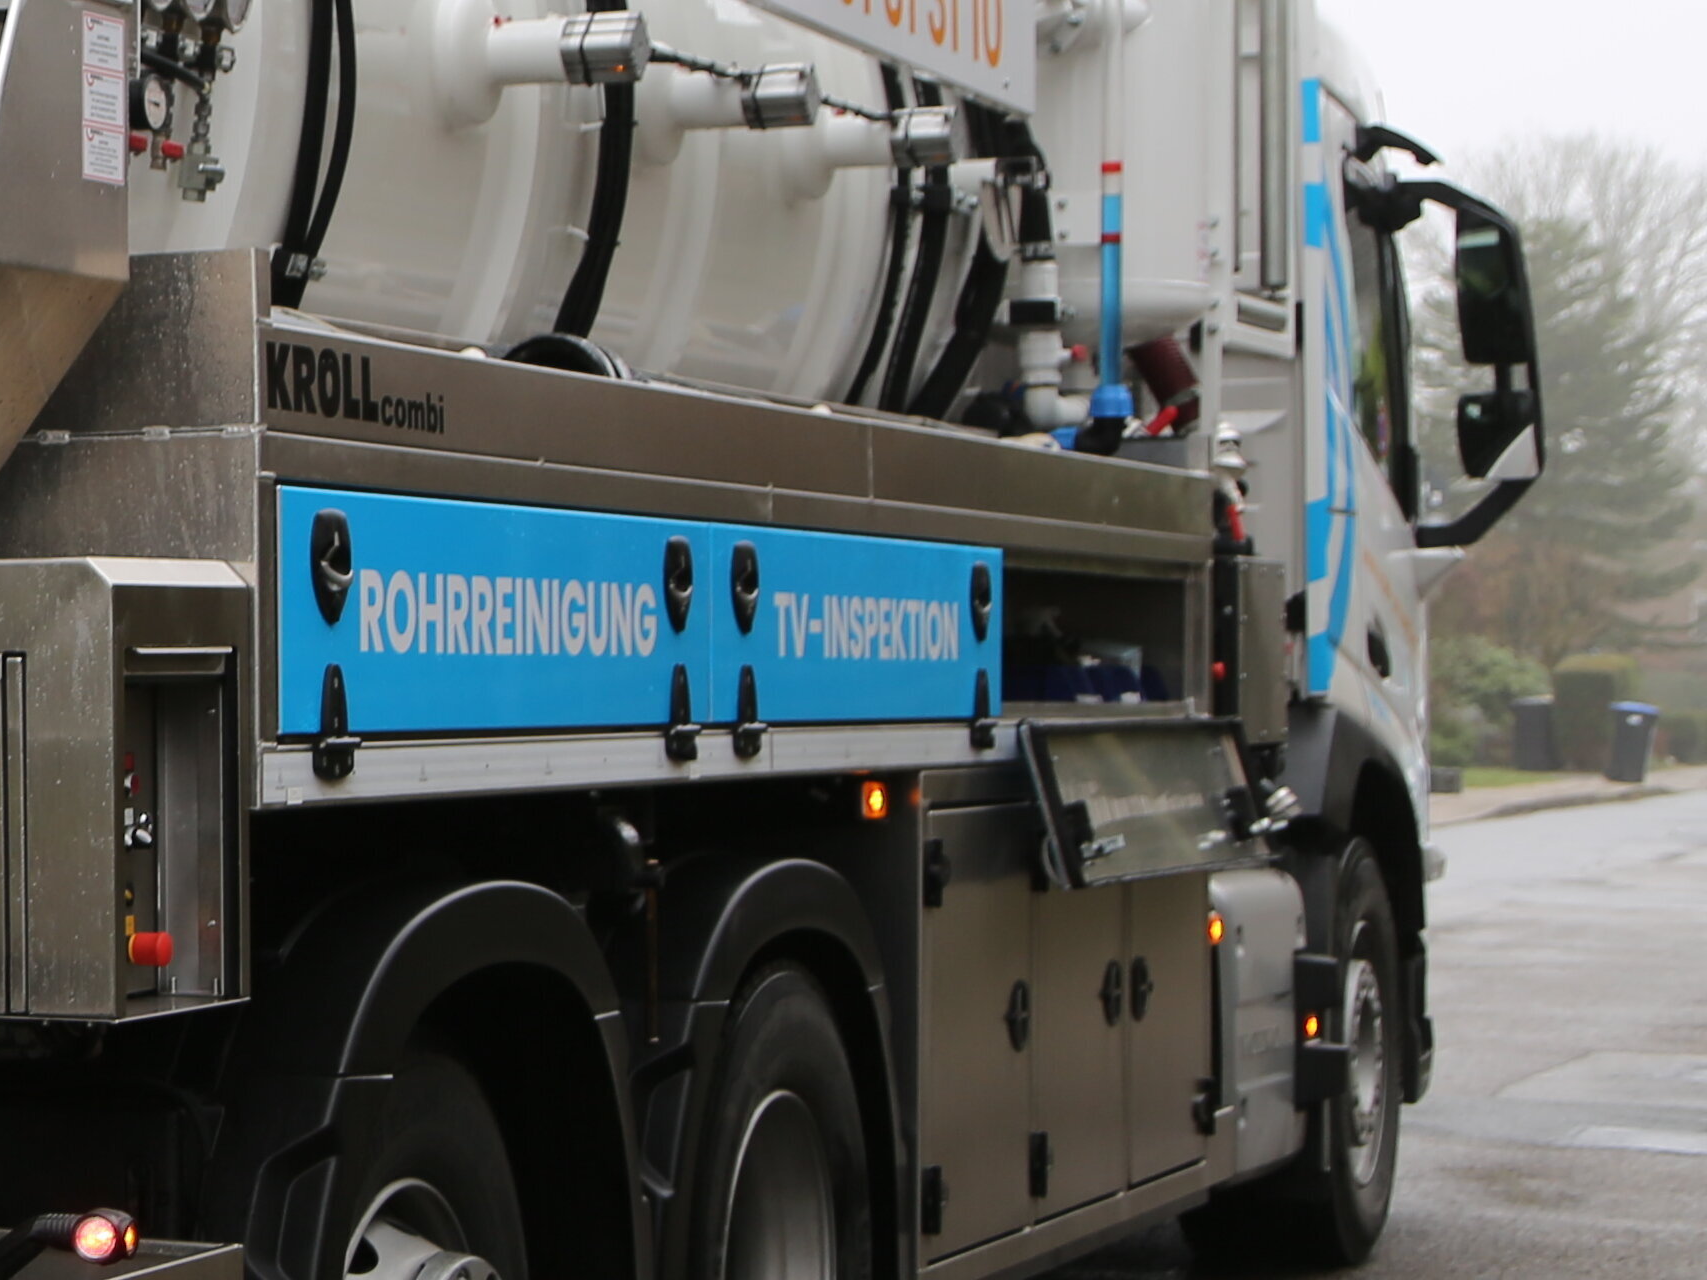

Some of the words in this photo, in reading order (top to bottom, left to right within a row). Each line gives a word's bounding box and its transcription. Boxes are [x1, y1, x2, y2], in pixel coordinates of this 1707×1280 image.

[380, 391, 445, 435] combi
[358, 568, 658, 659] ROHRREINIGUNG
[773, 590, 960, 663] TV-INSPEKTION
